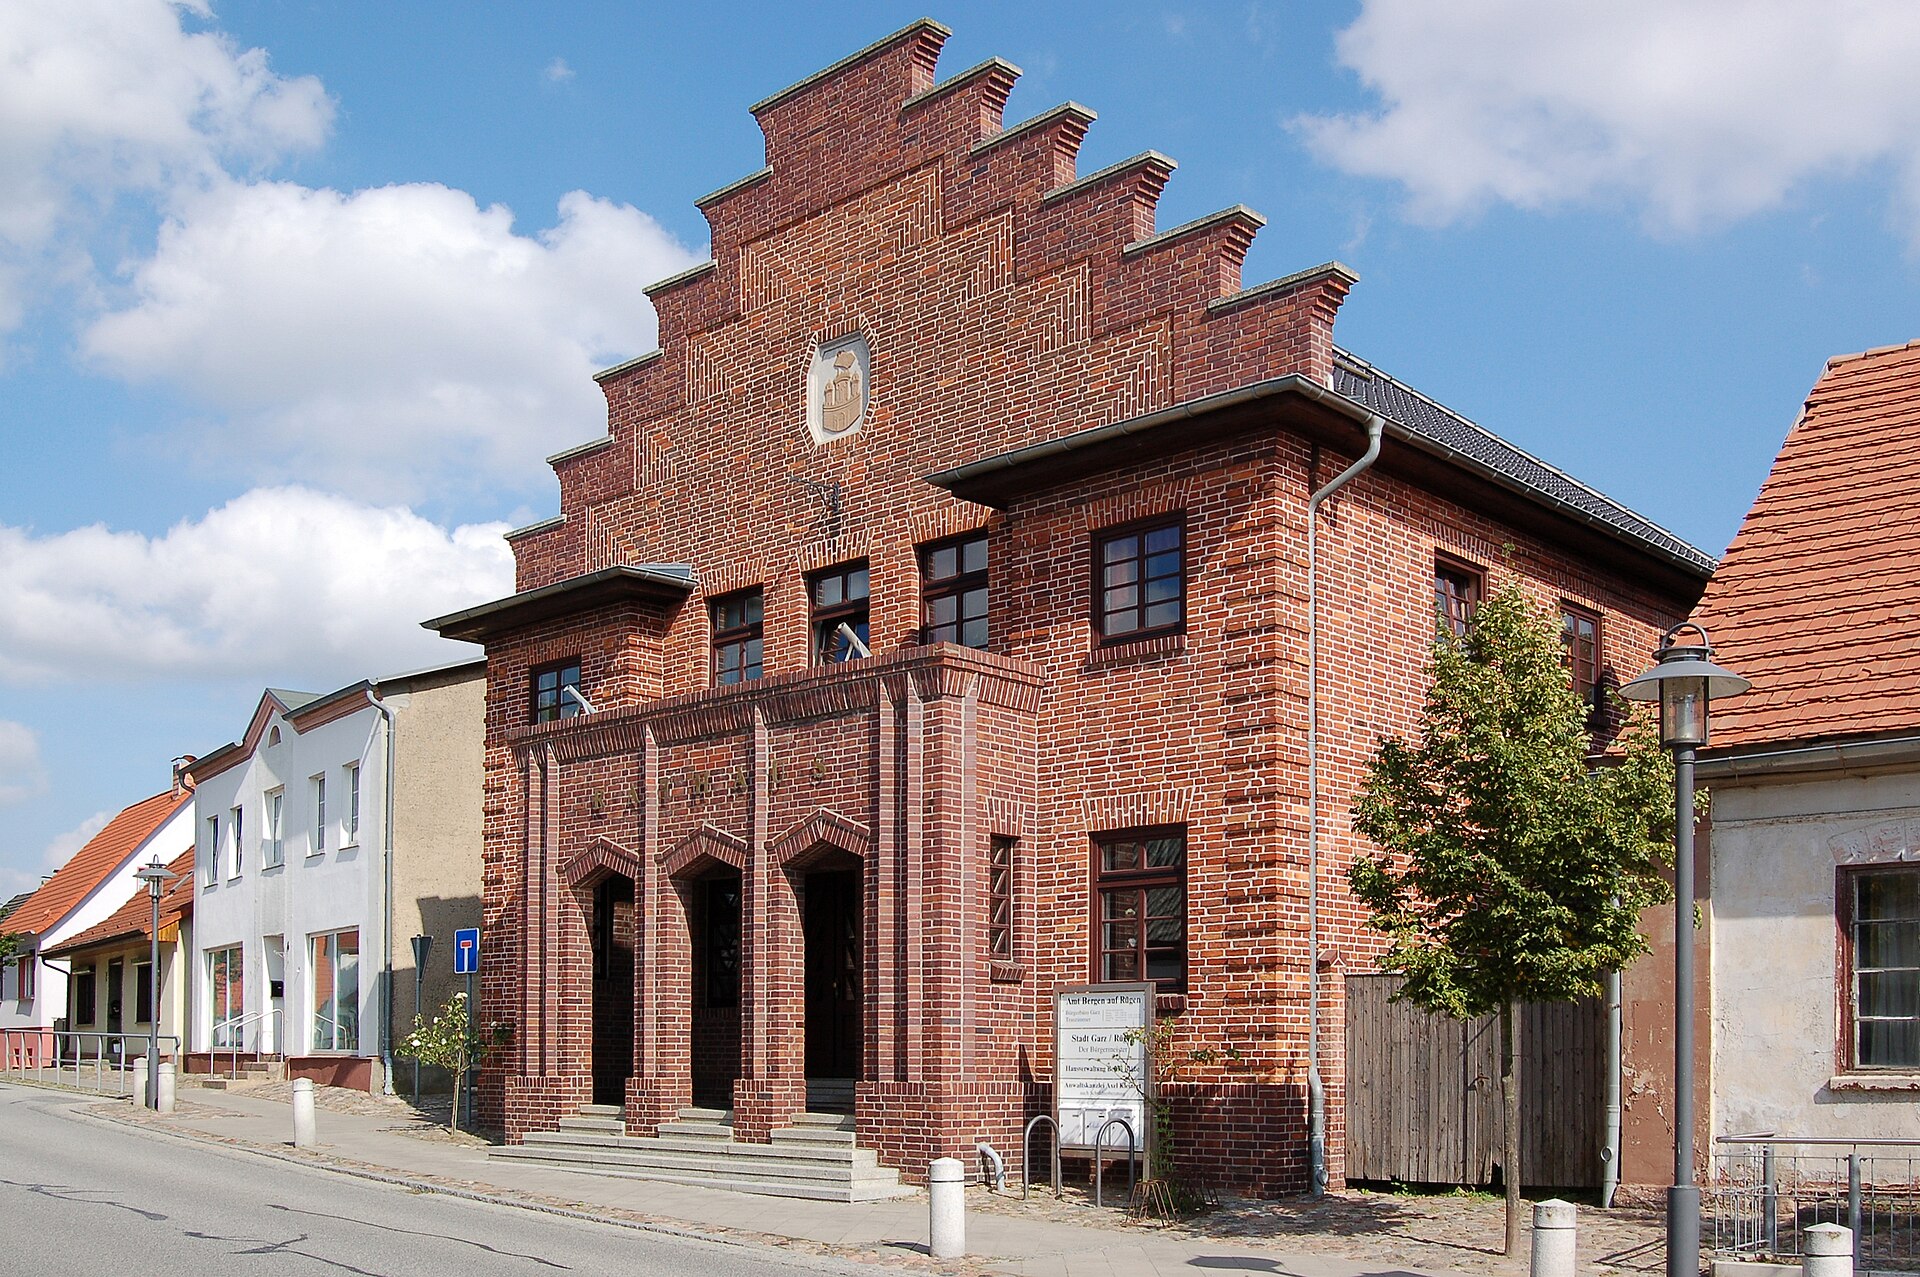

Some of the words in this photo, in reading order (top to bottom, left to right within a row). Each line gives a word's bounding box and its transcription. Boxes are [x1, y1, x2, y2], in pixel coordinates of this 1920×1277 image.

[593, 756, 826, 808] RATHAUS
[1082, 996, 1105, 1006] Bergen
[1107, 996, 1118, 1005] auf
[1120, 995, 1141, 1005] Rügen
[1071, 1034, 1089, 1043] Stadt
[1091, 1034, 1107, 1043] Garz
[1090, 1046, 1128, 1054] Bürgermeister
